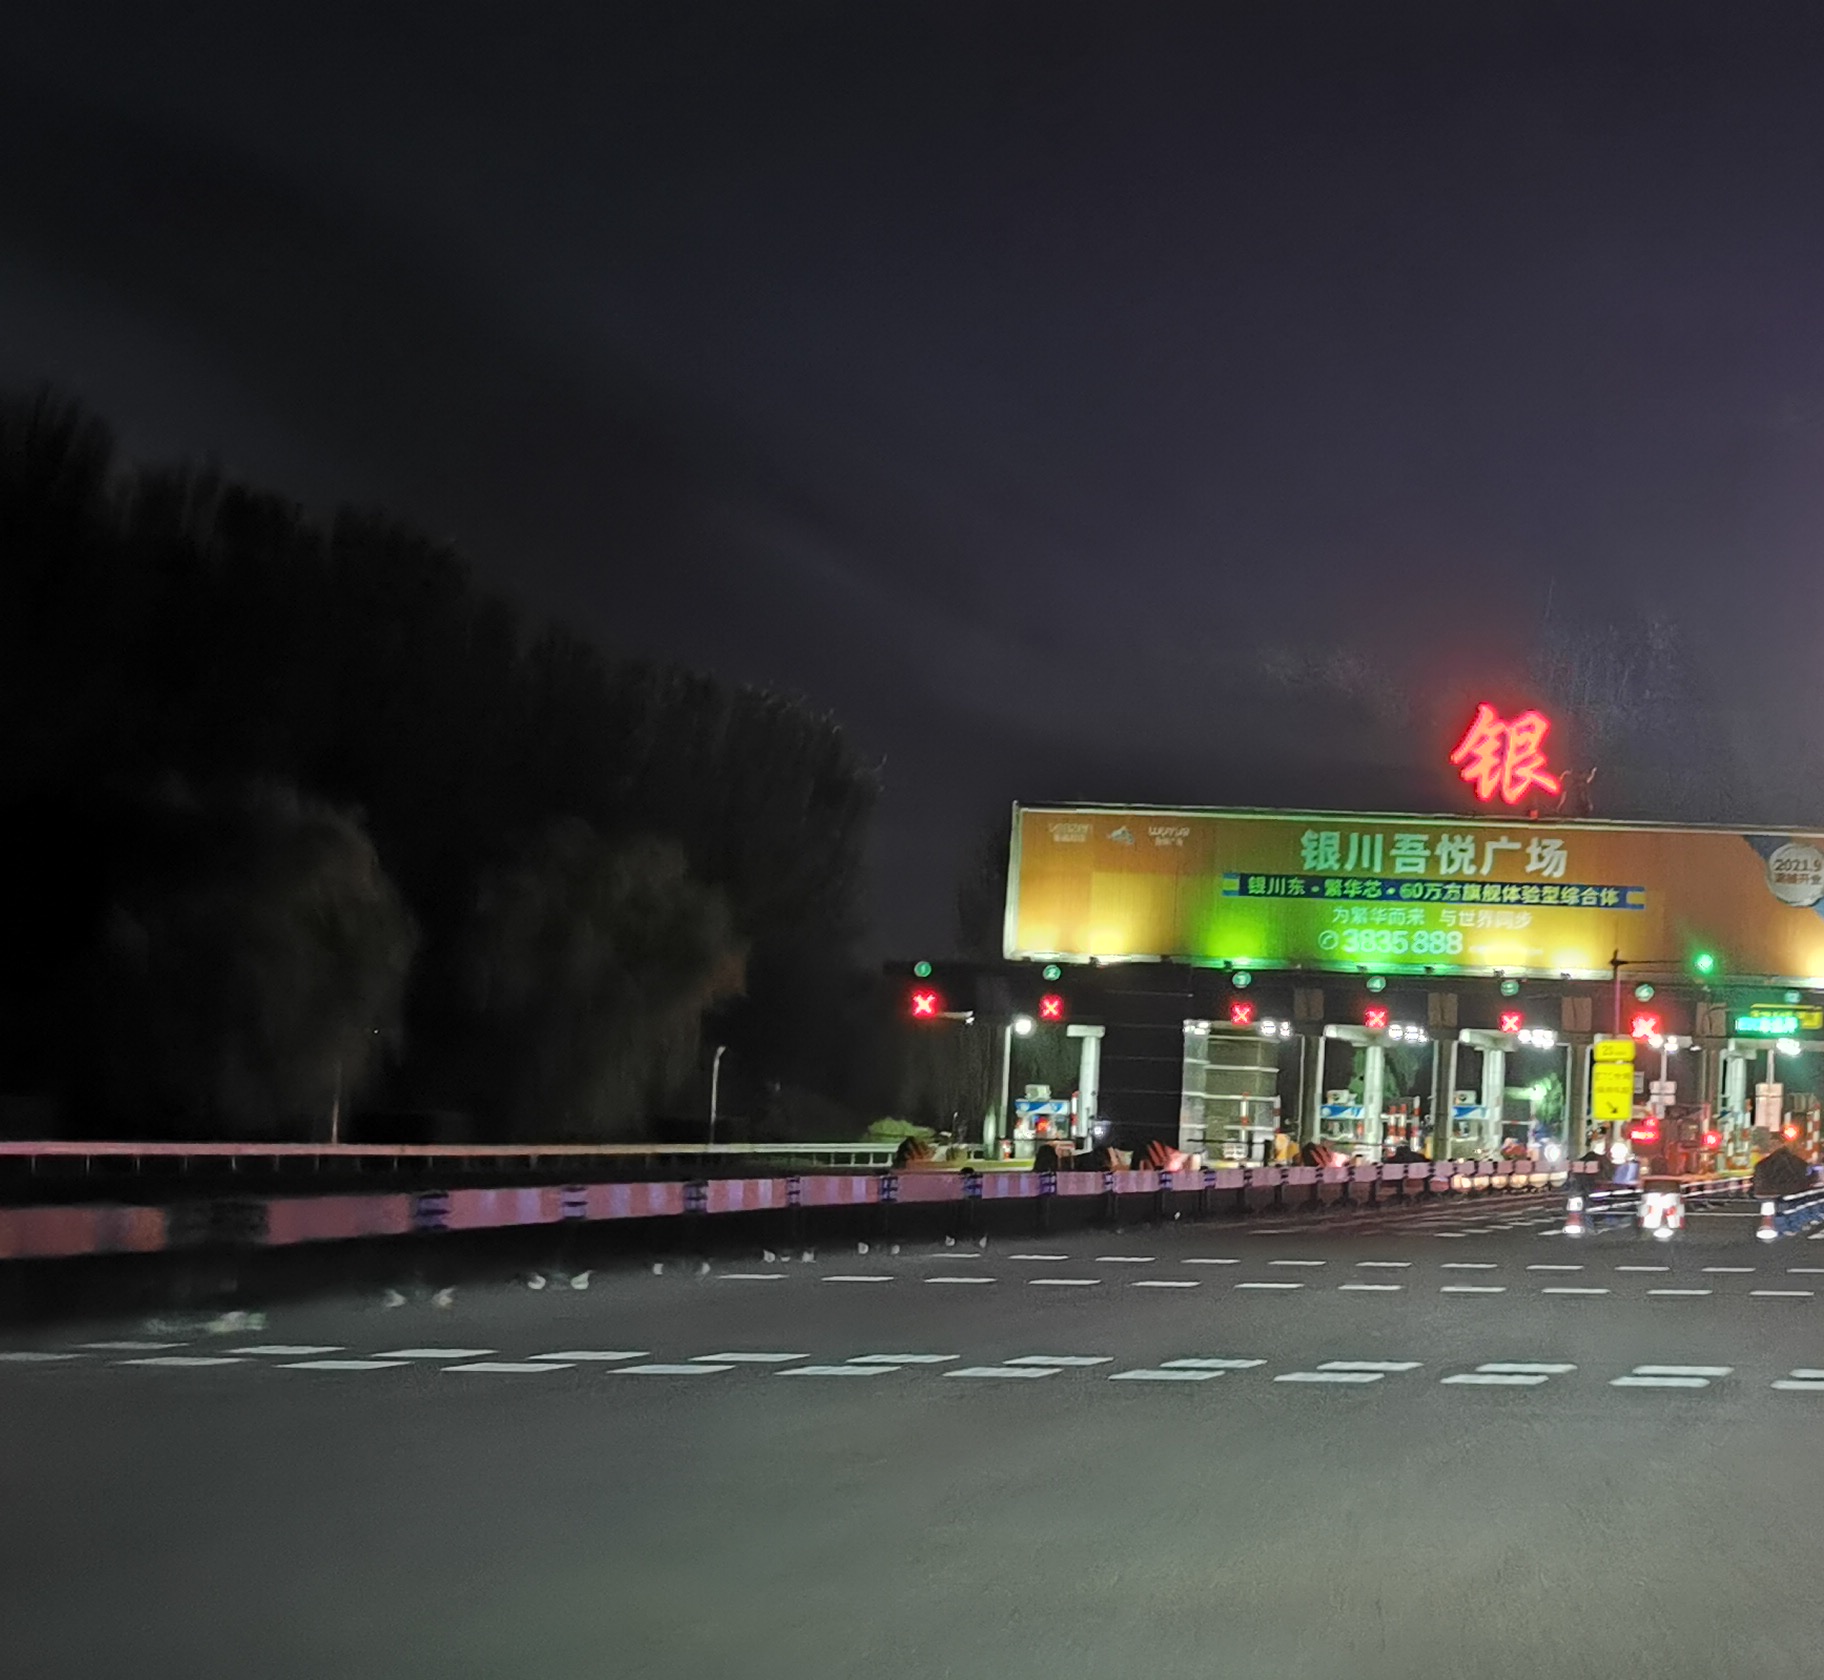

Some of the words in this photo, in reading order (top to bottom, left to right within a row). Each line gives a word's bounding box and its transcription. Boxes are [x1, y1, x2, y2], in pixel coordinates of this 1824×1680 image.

[1450, 702, 1561, 804] 银
[1300, 828, 1568, 878] 银川吾悦广场
